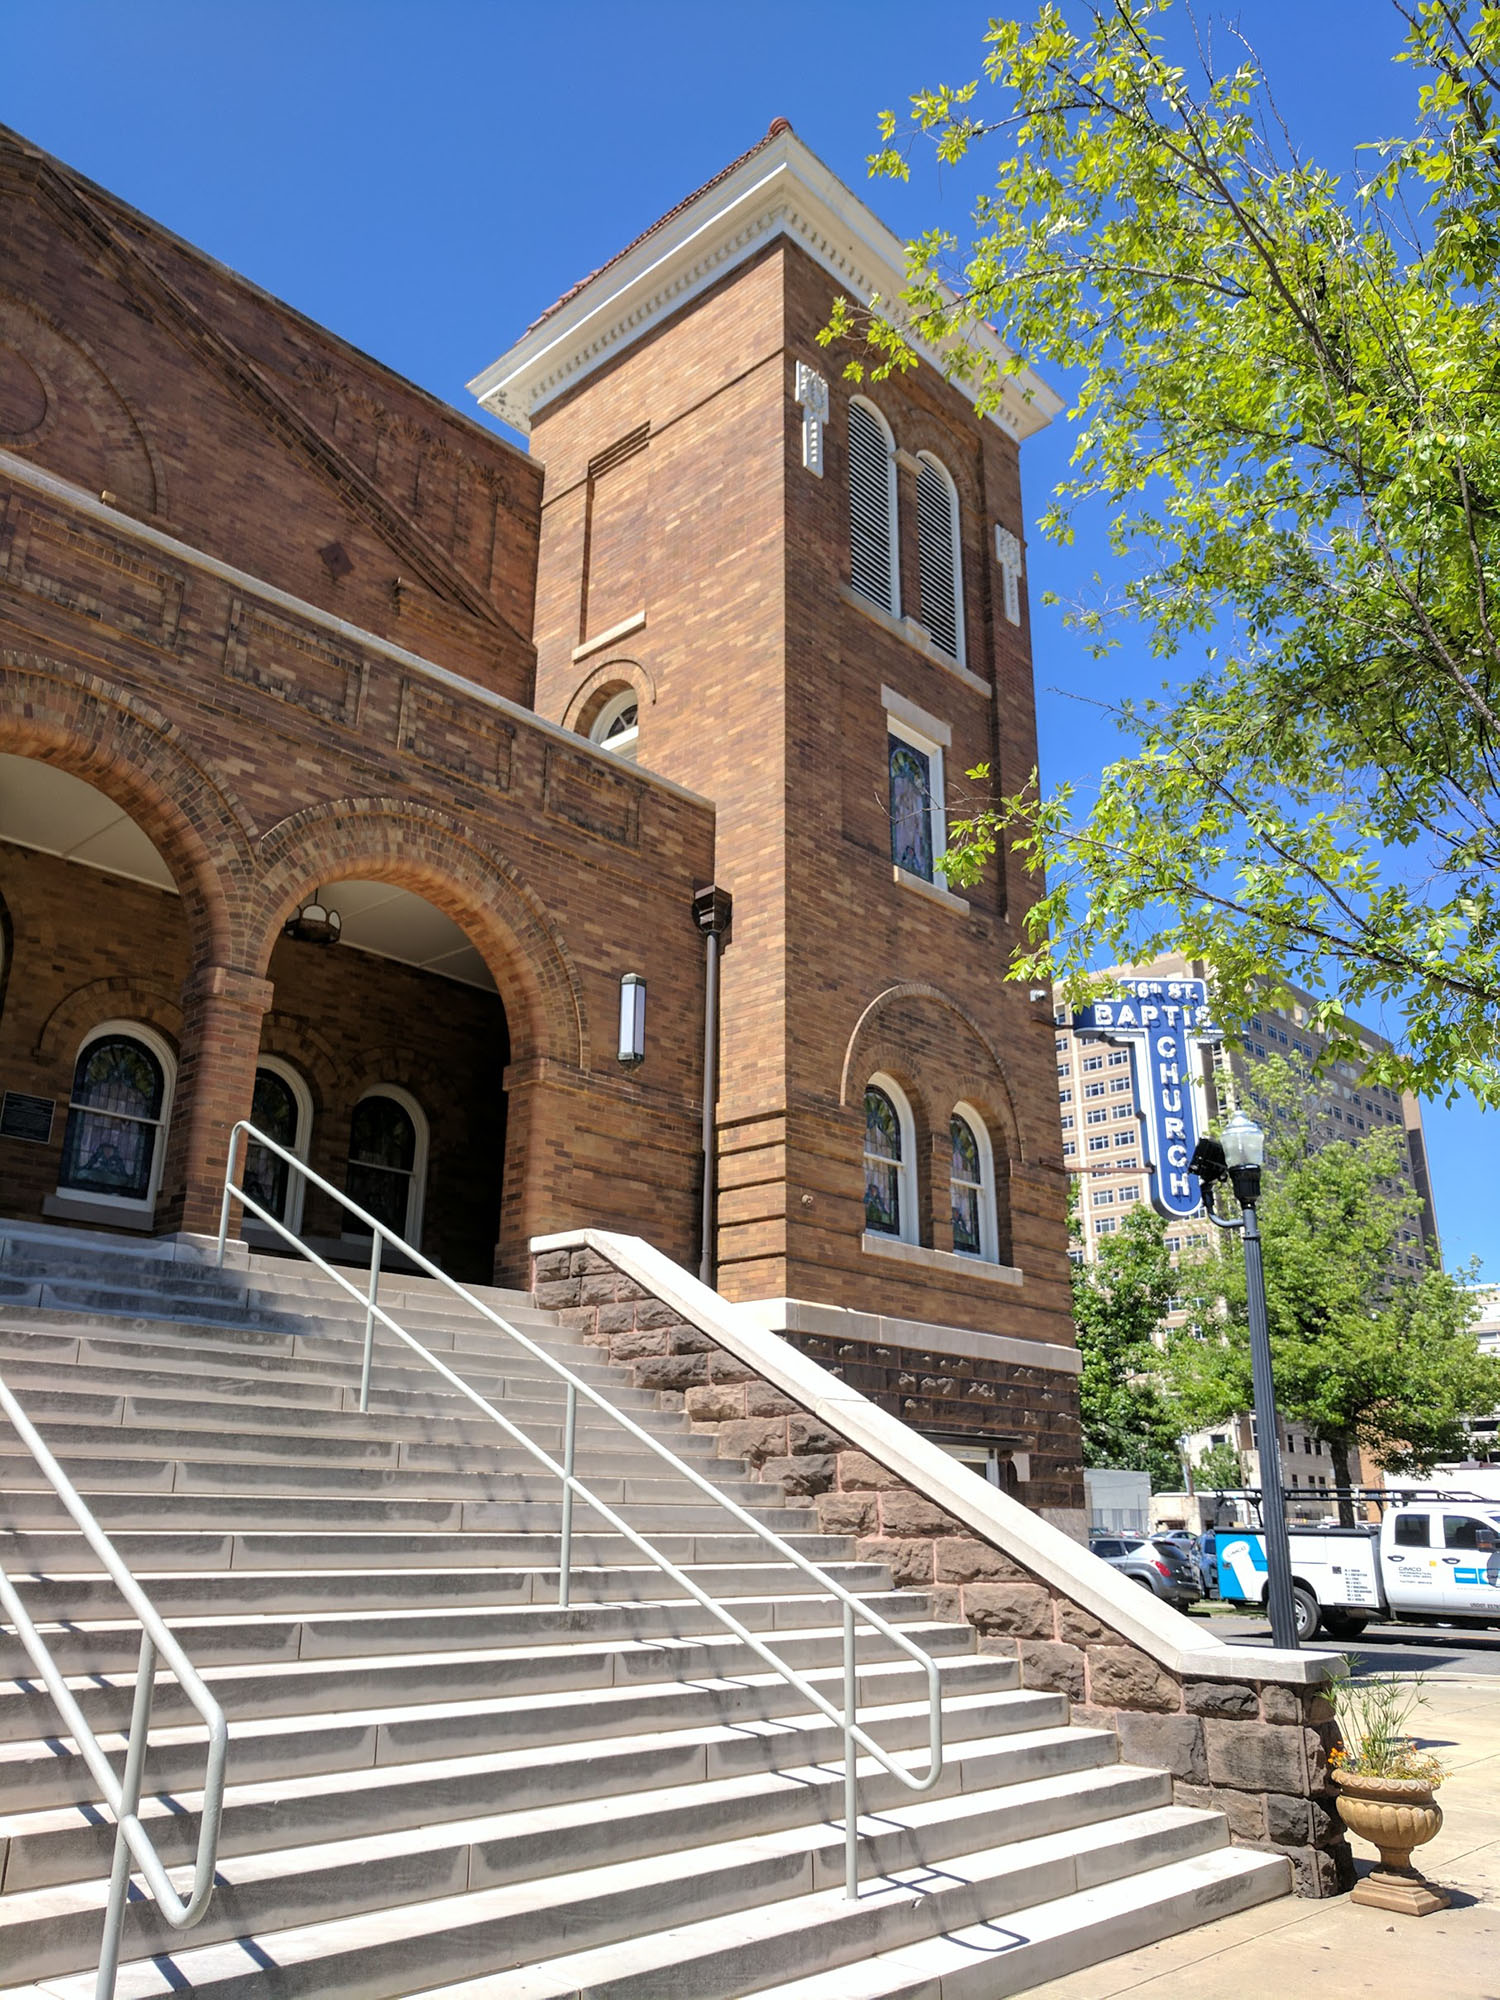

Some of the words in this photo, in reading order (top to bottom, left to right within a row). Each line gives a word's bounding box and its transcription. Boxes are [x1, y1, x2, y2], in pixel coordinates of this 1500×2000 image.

[1168, 982, 1199, 1000] ST.
[1094, 1004, 1215, 1028] BAPTIS
[1156, 1035, 1190, 1198] CHURCH
